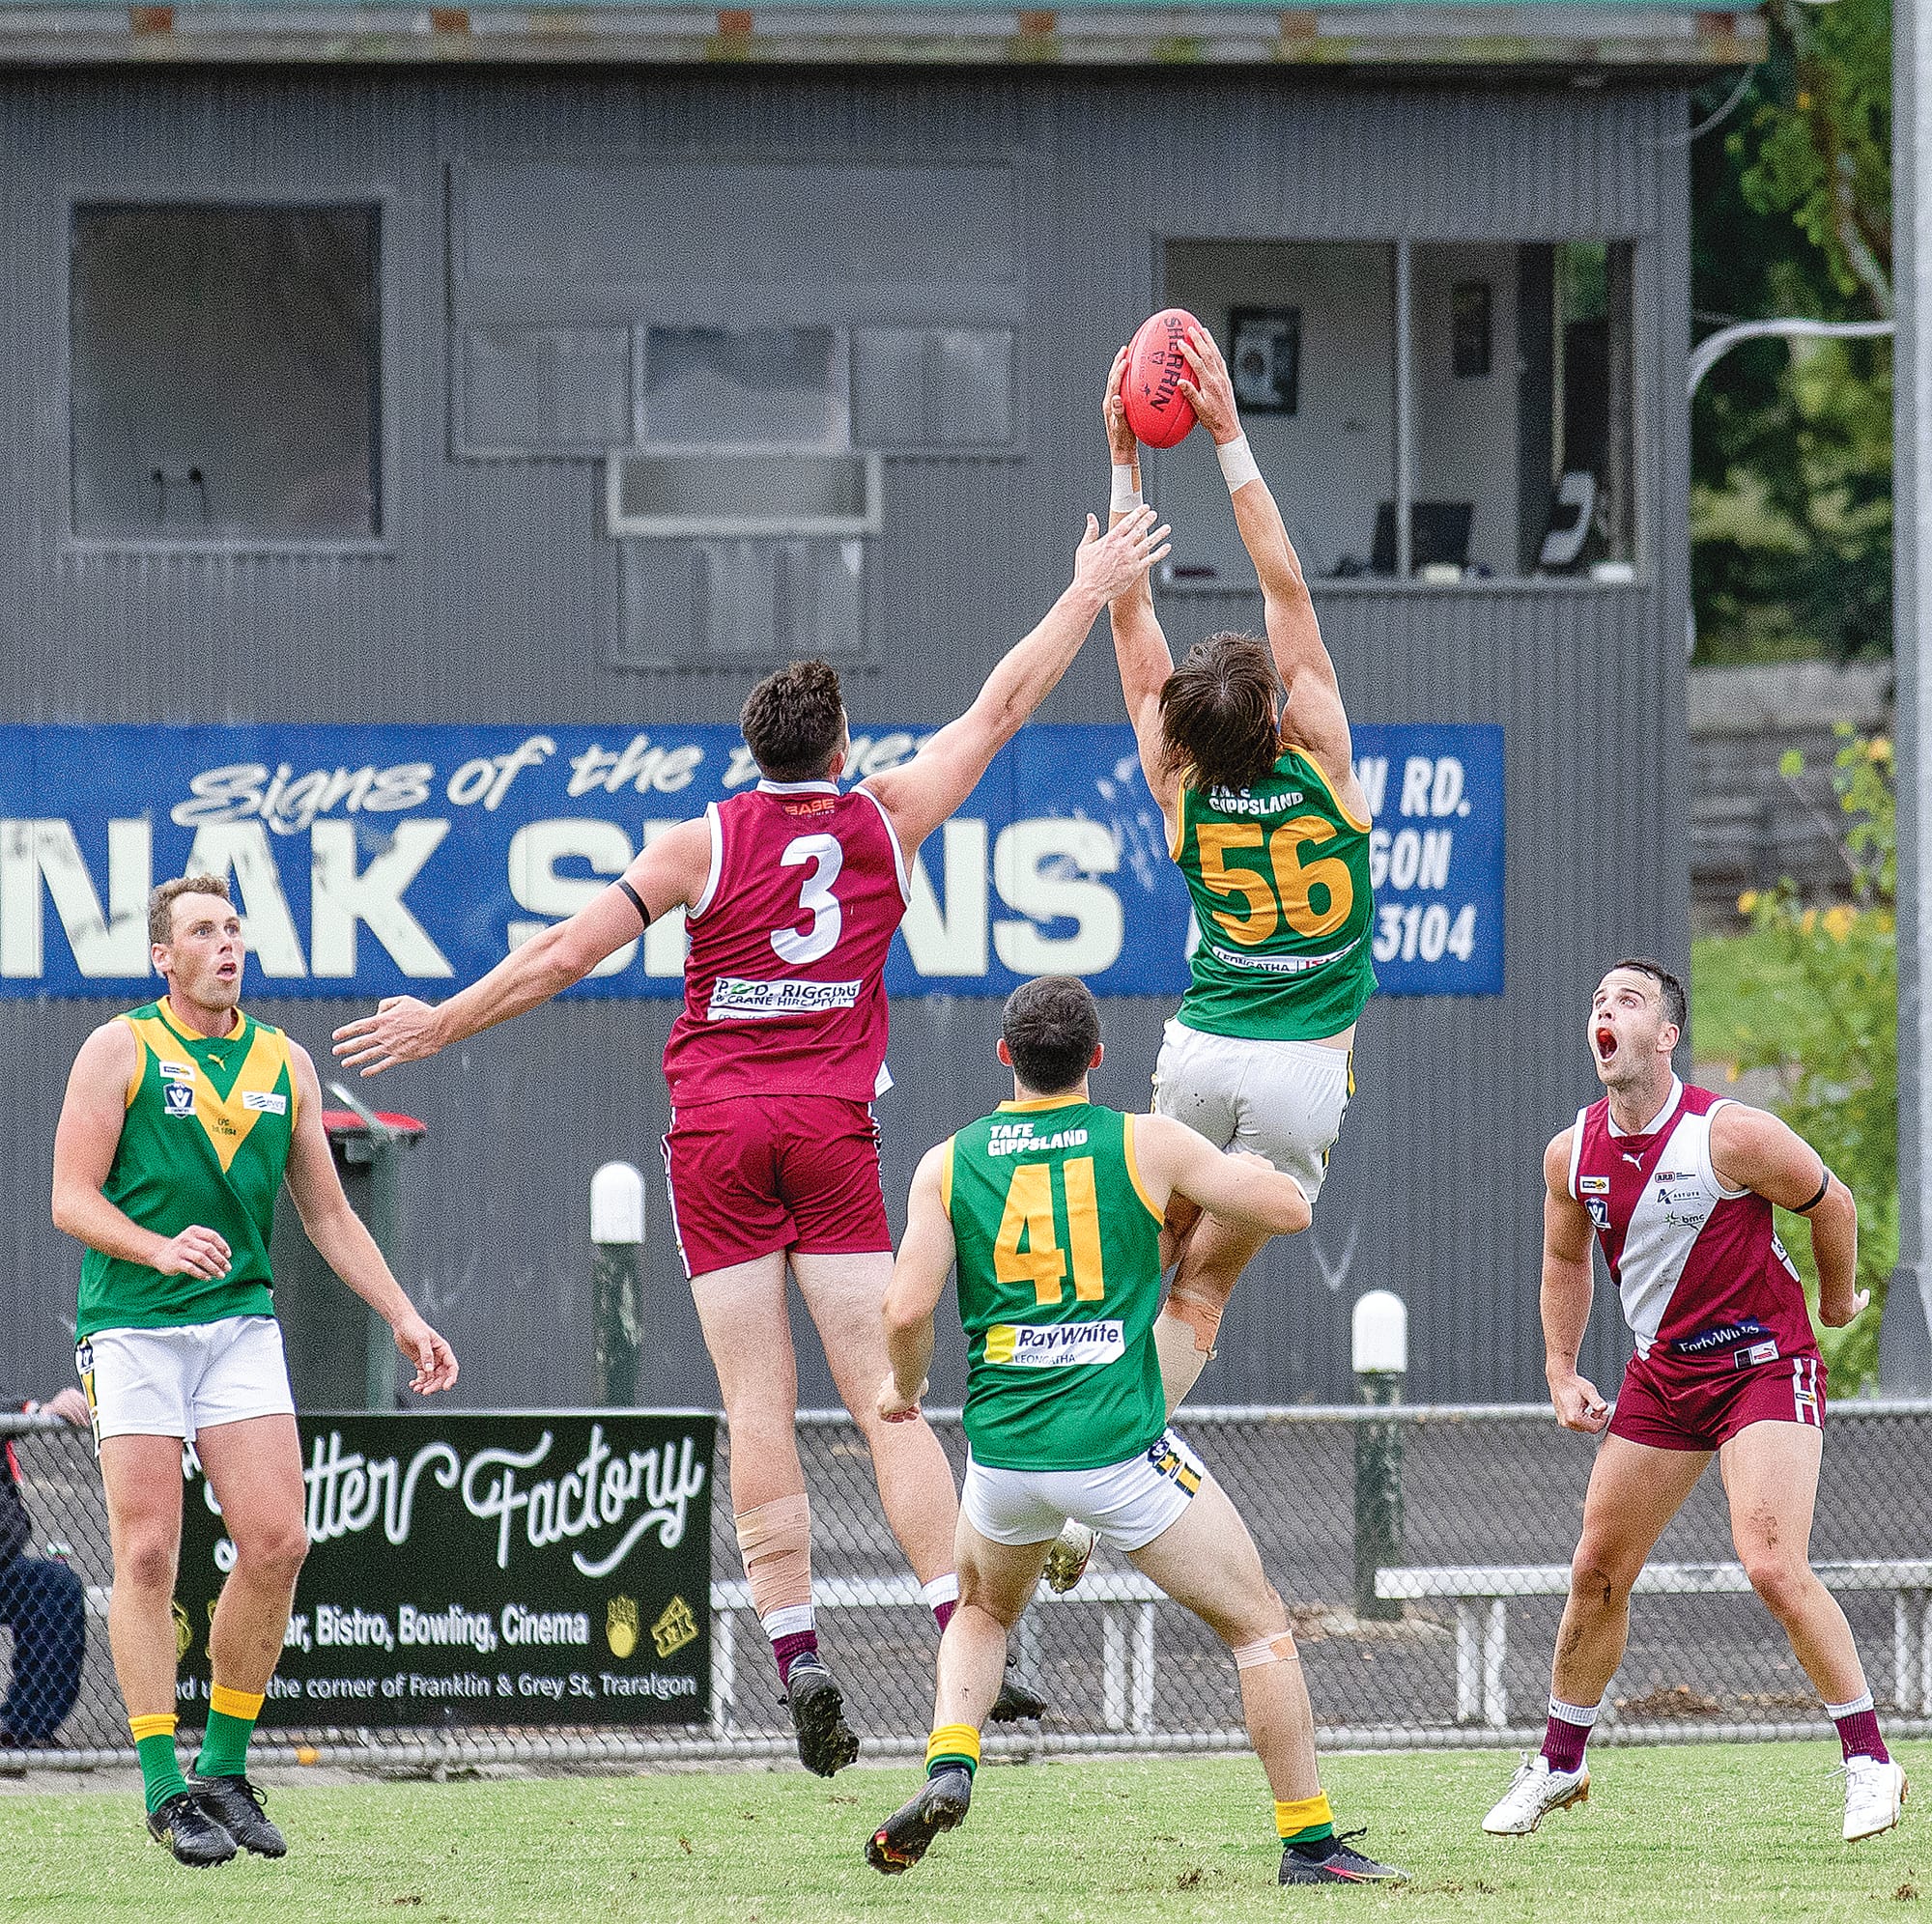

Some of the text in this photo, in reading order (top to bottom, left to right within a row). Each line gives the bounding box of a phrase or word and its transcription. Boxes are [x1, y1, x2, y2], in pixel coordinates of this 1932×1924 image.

[1150, 316, 1186, 413] SHERRIN
[170, 762, 435, 835] Signs
[446, 732, 556, 811] of
[566, 732, 703, 794] the
[1208, 792, 1304, 815] GIPPSLAND
[1399, 756, 1472, 817] RD.
[507, 817, 1124, 978] SINS
[770, 833, 843, 965] 3
[1196, 814, 1353, 946] 56
[1373, 904, 1478, 963] 3104
[726, 995, 774, 1005] CRANE
[986, 1128, 1090, 1157] GIPPSLAND
[989, 1122, 1035, 1140] TAFE
[993, 1156, 1105, 1306] 41
[1681, 1214, 1705, 1224] bmc
[1014, 1353, 1076, 1365] LEONGATHA
[461, 1424, 704, 1578] Factory
[284, 1603, 589, 1654] ar, Bistro, Bowling, Cinema
[267, 1676, 300, 1699] the
[306, 1680, 377, 1700] corner
[381, 1672, 408, 1698] of
[409, 1671, 491, 1699] Franklin
[497, 1673, 514, 1697] &
[518, 1672, 563, 1704] Grey
[568, 1672, 595, 1701] St,
[600, 1668, 697, 1703] Traralgon
